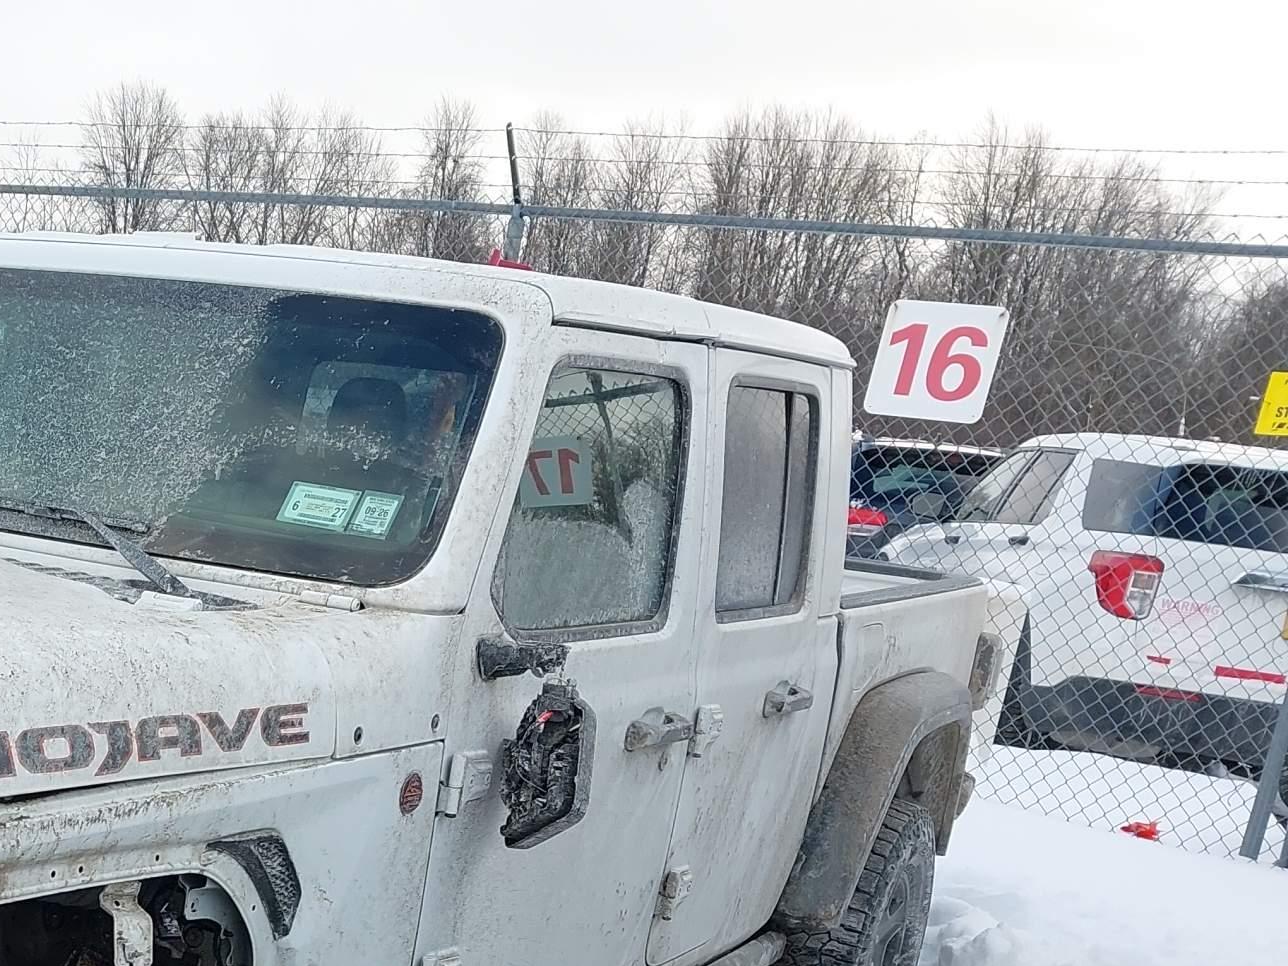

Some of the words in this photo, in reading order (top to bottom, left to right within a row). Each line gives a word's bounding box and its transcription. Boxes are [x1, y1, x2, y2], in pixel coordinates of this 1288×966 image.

[889, 323, 988, 402] 16
[292, 500, 301, 511] 6
[331, 507, 347, 519] 27
